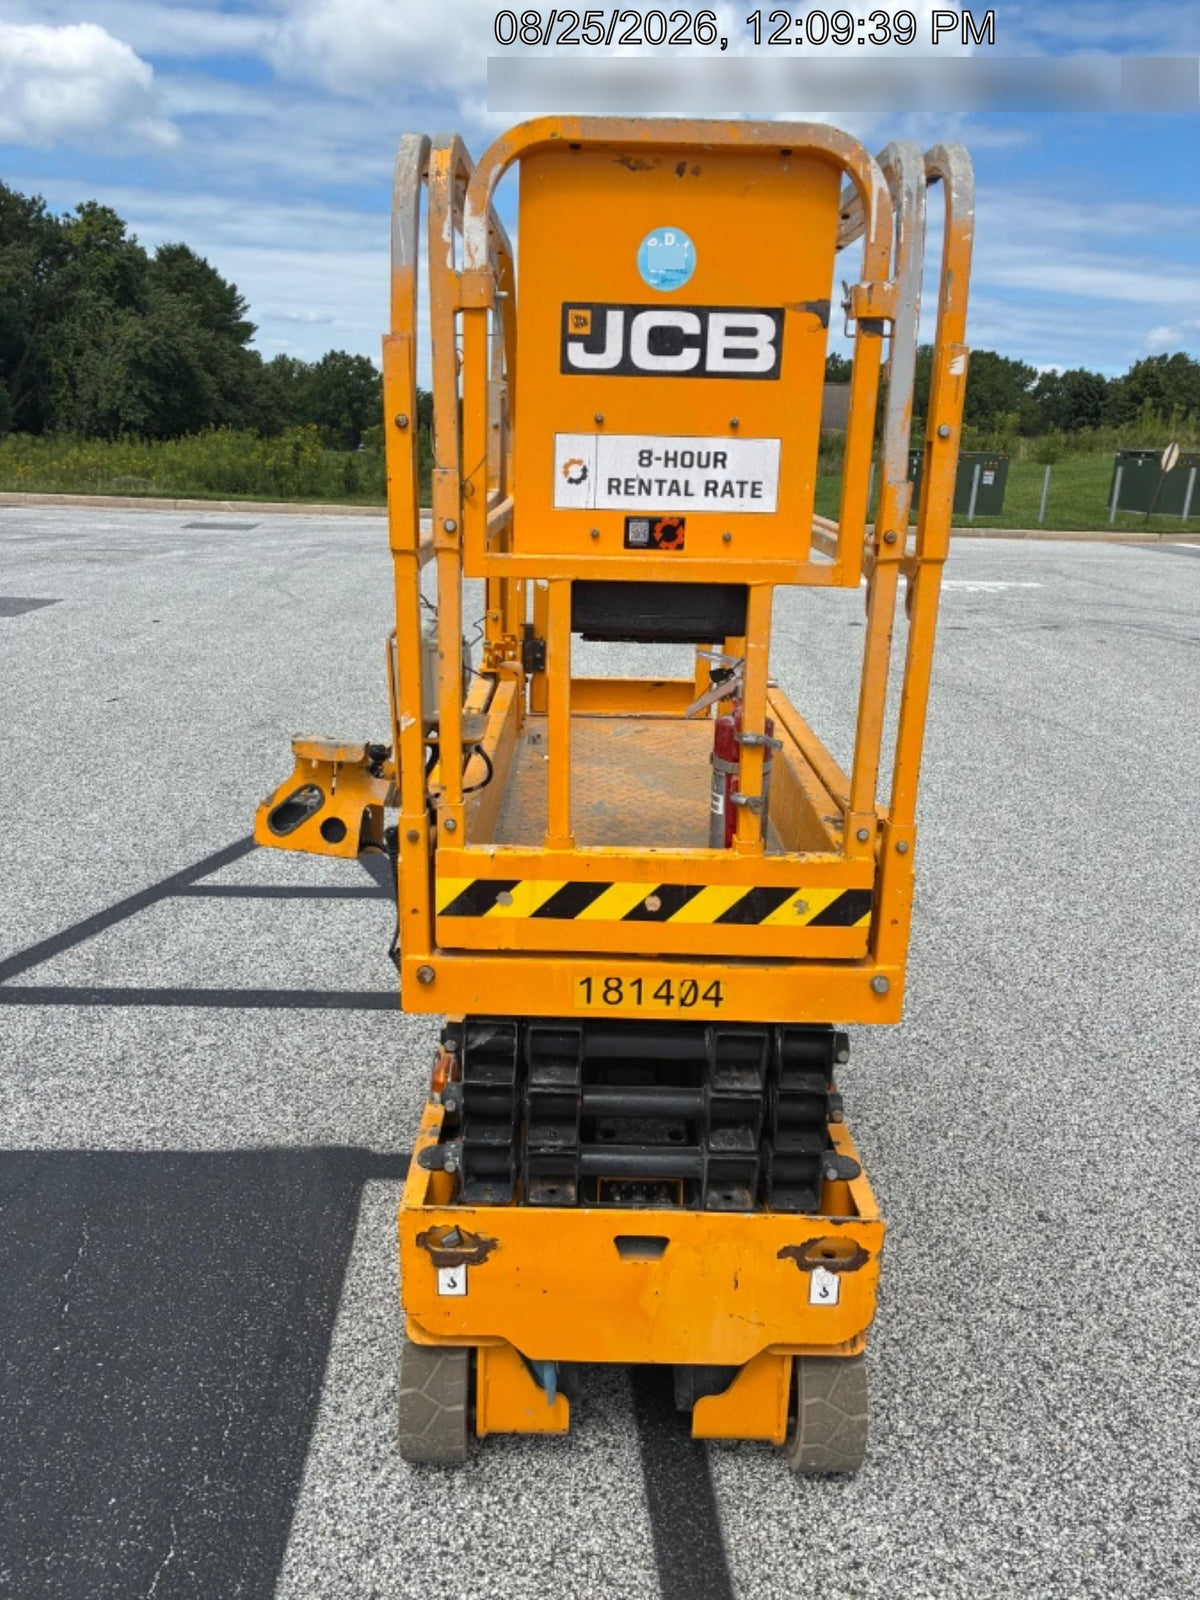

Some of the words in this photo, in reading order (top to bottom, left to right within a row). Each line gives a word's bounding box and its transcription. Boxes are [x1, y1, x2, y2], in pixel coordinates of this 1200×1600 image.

[567, 310, 777, 373] JCB
[638, 449, 728, 469] 8-HOUR
[607, 477, 695, 497] RENTAL
[703, 479, 763, 498] RATE
[579, 976, 724, 1008] 181404
